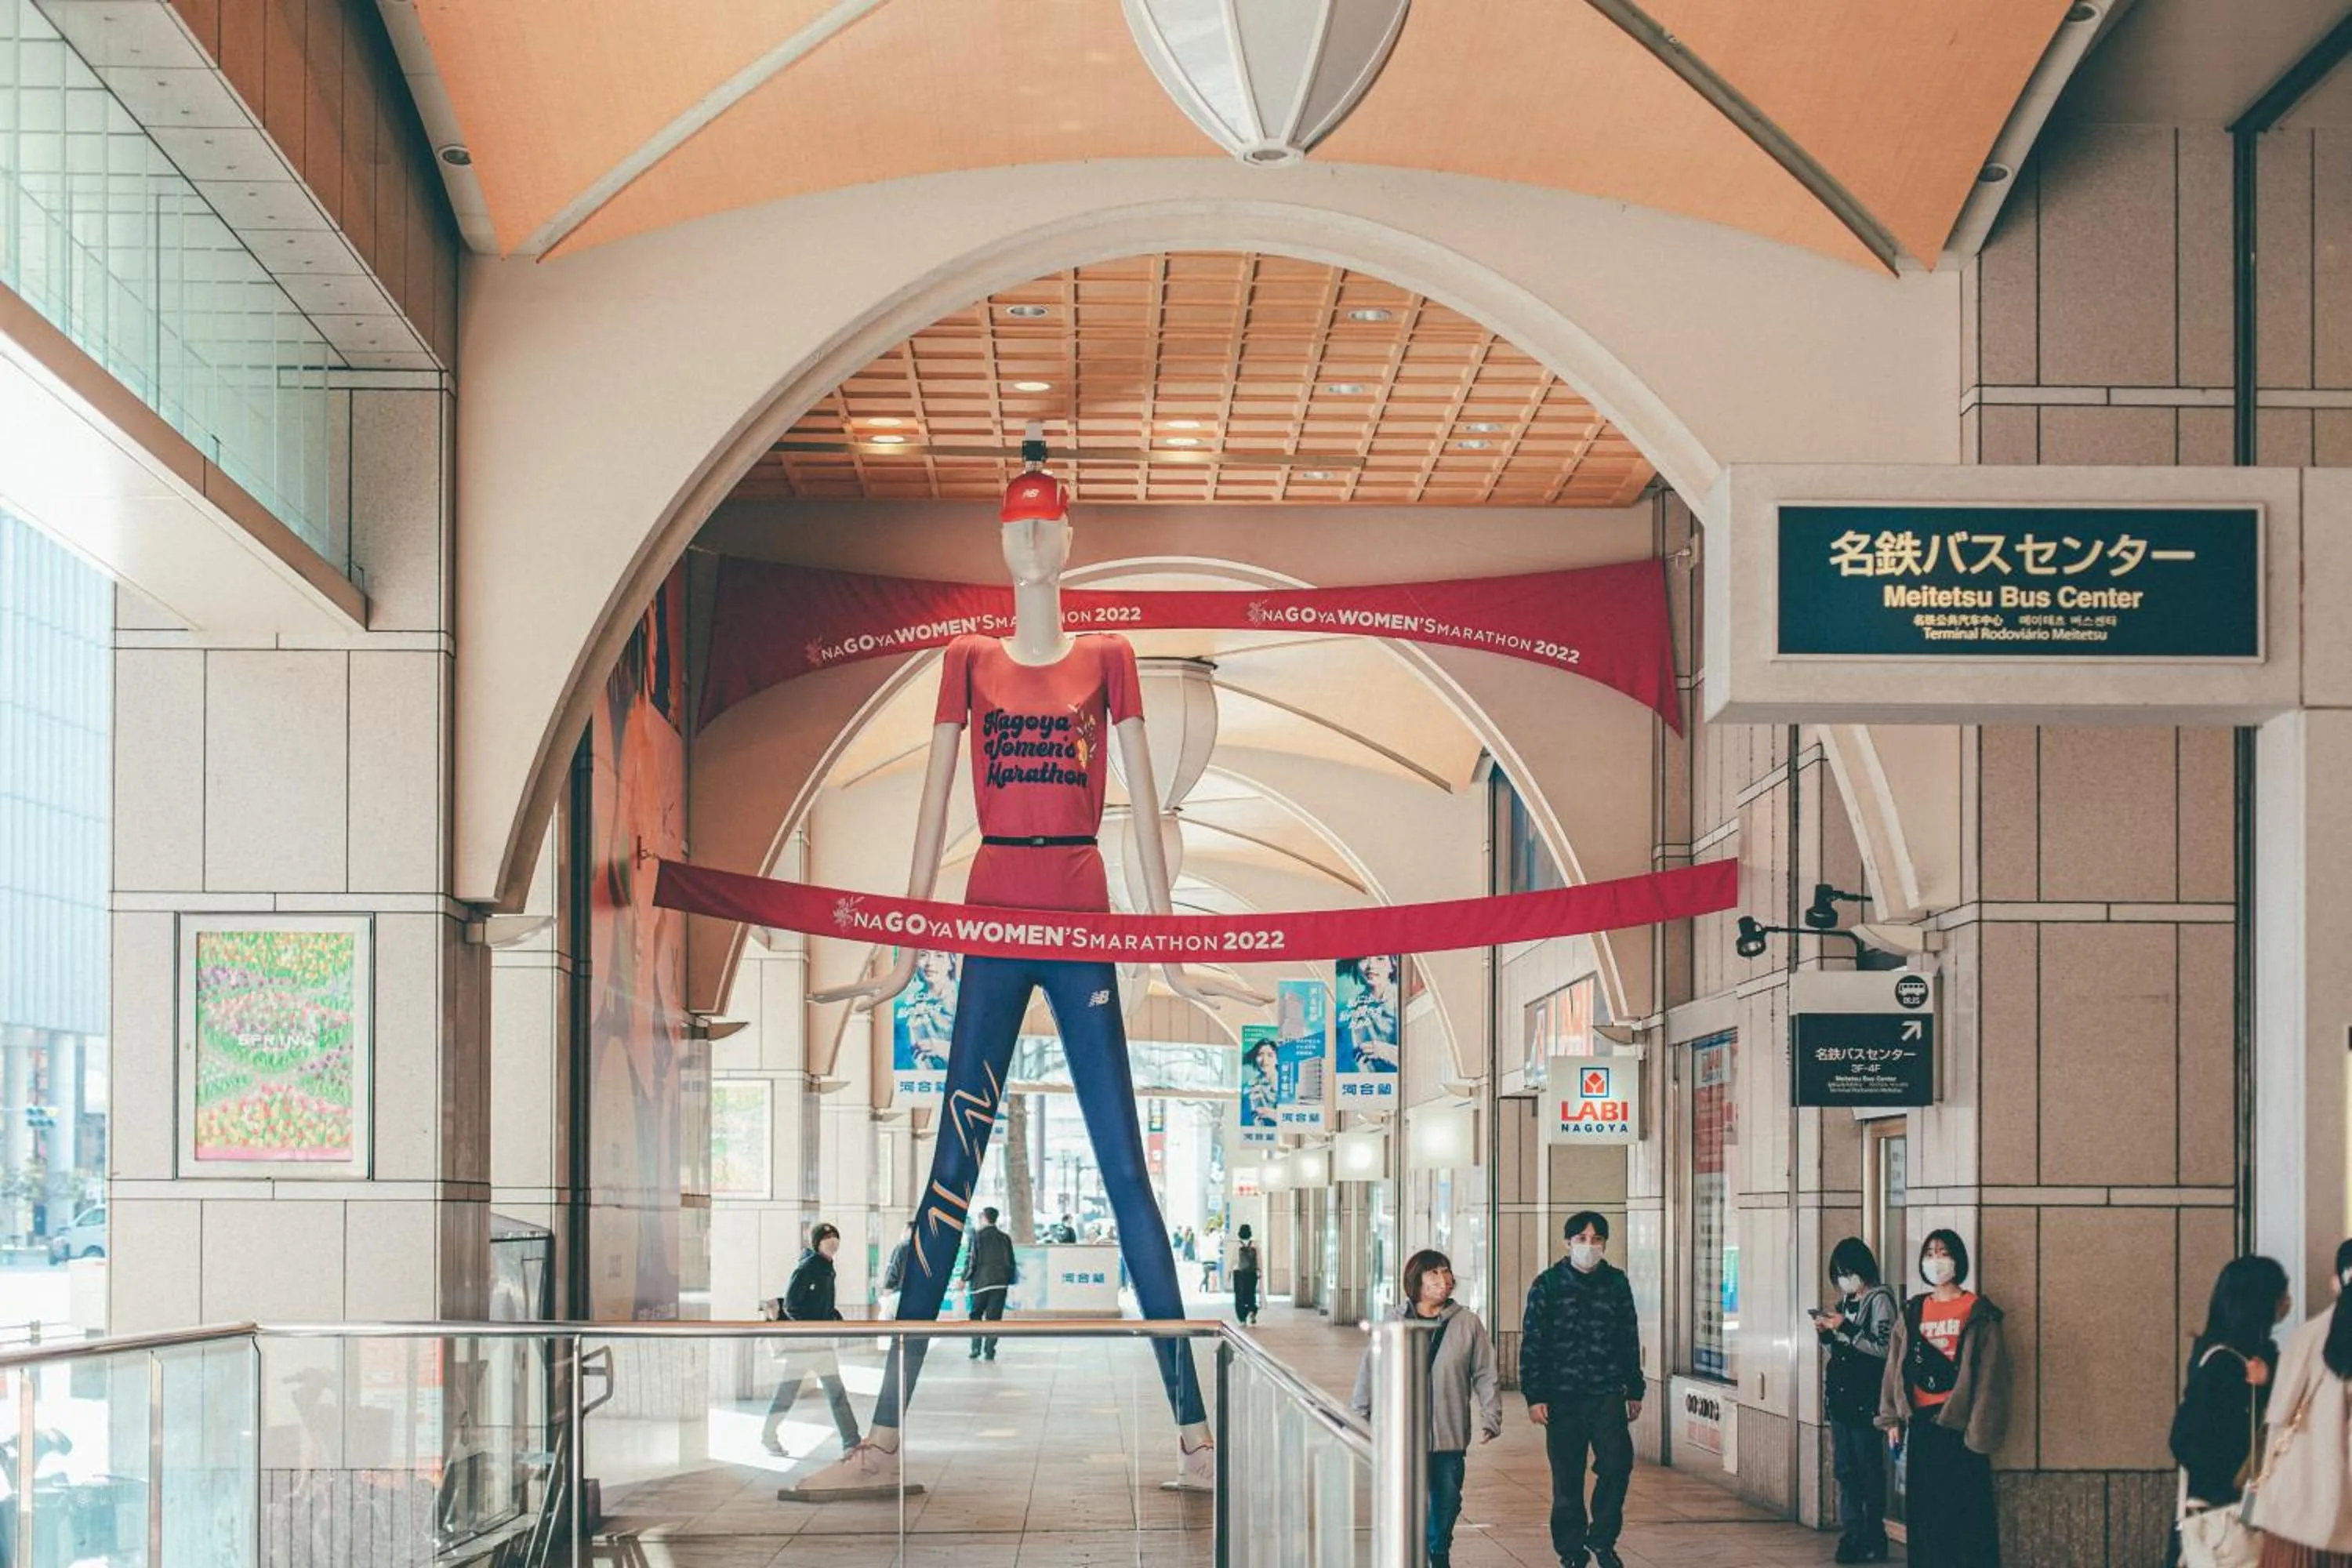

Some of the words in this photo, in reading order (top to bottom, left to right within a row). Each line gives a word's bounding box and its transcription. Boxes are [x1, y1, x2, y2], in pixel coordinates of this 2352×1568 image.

[1829, 530, 2196, 578] 名鉄バスセンター
[1884, 585, 1993, 609] Meitetsu
[2001, 586, 2052, 609] Bus
[2057, 586, 2143, 610] Center
[1094, 607, 1142, 622] 2022
[1923, 626, 1978, 641] Terminal
[2051, 627, 2108, 641] Meitetsu
[1533, 639, 1581, 665] 2022
[983, 708, 1071, 739] Nagoya
[986, 761, 1087, 789] Marathon
[1222, 930, 1286, 950] 2022
[1815, 1047, 1916, 1061] 名鉄バスセンター
[1342, 1083, 1392, 1096] 河合塾
[1561, 1101, 1629, 1121] LABI
[1561, 1123, 1628, 1133] NAGOYA
